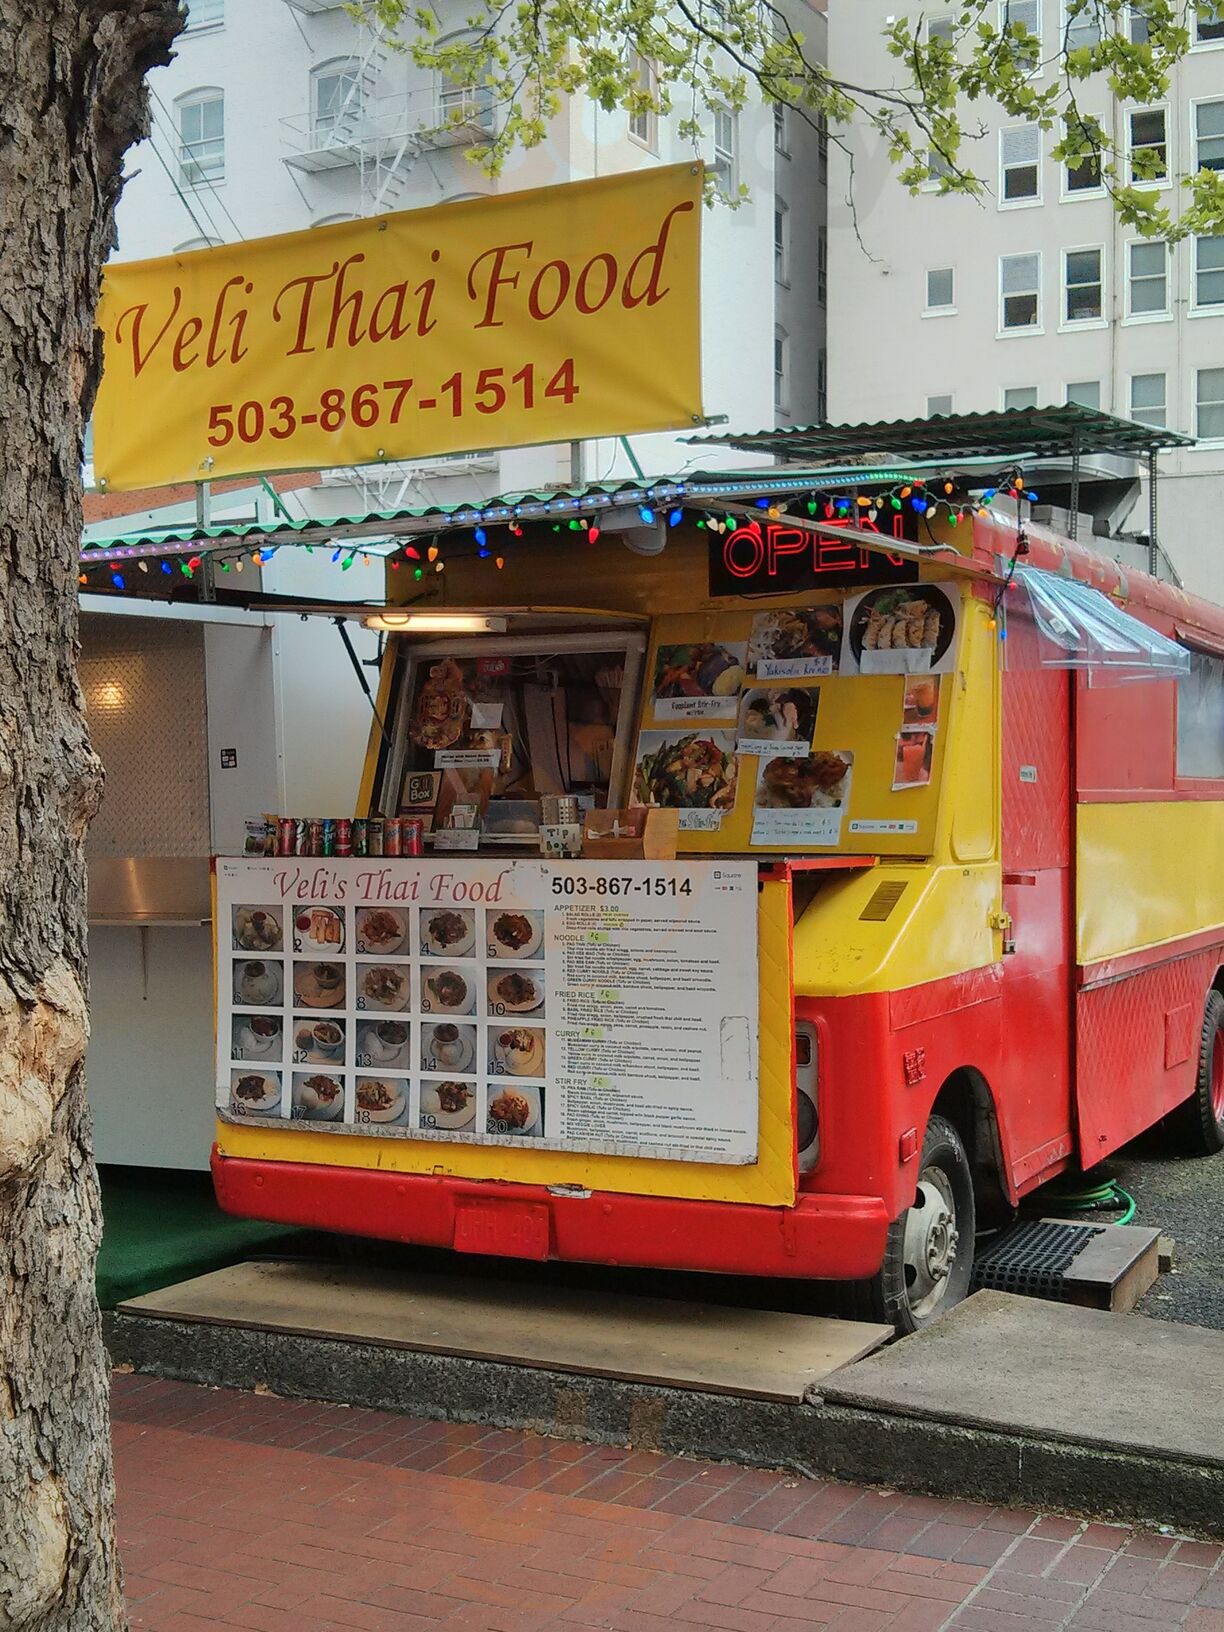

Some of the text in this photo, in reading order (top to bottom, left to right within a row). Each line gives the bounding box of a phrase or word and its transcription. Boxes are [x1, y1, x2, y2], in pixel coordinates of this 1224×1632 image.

[116, 200, 694, 378] Veli Thai Food
[207, 359, 579, 447] 503-867-1514
[724, 514, 904, 577] OPEN
[273, 868, 514, 902] Veli's Thai Food
[552, 878, 692, 896] 503-867-1514
